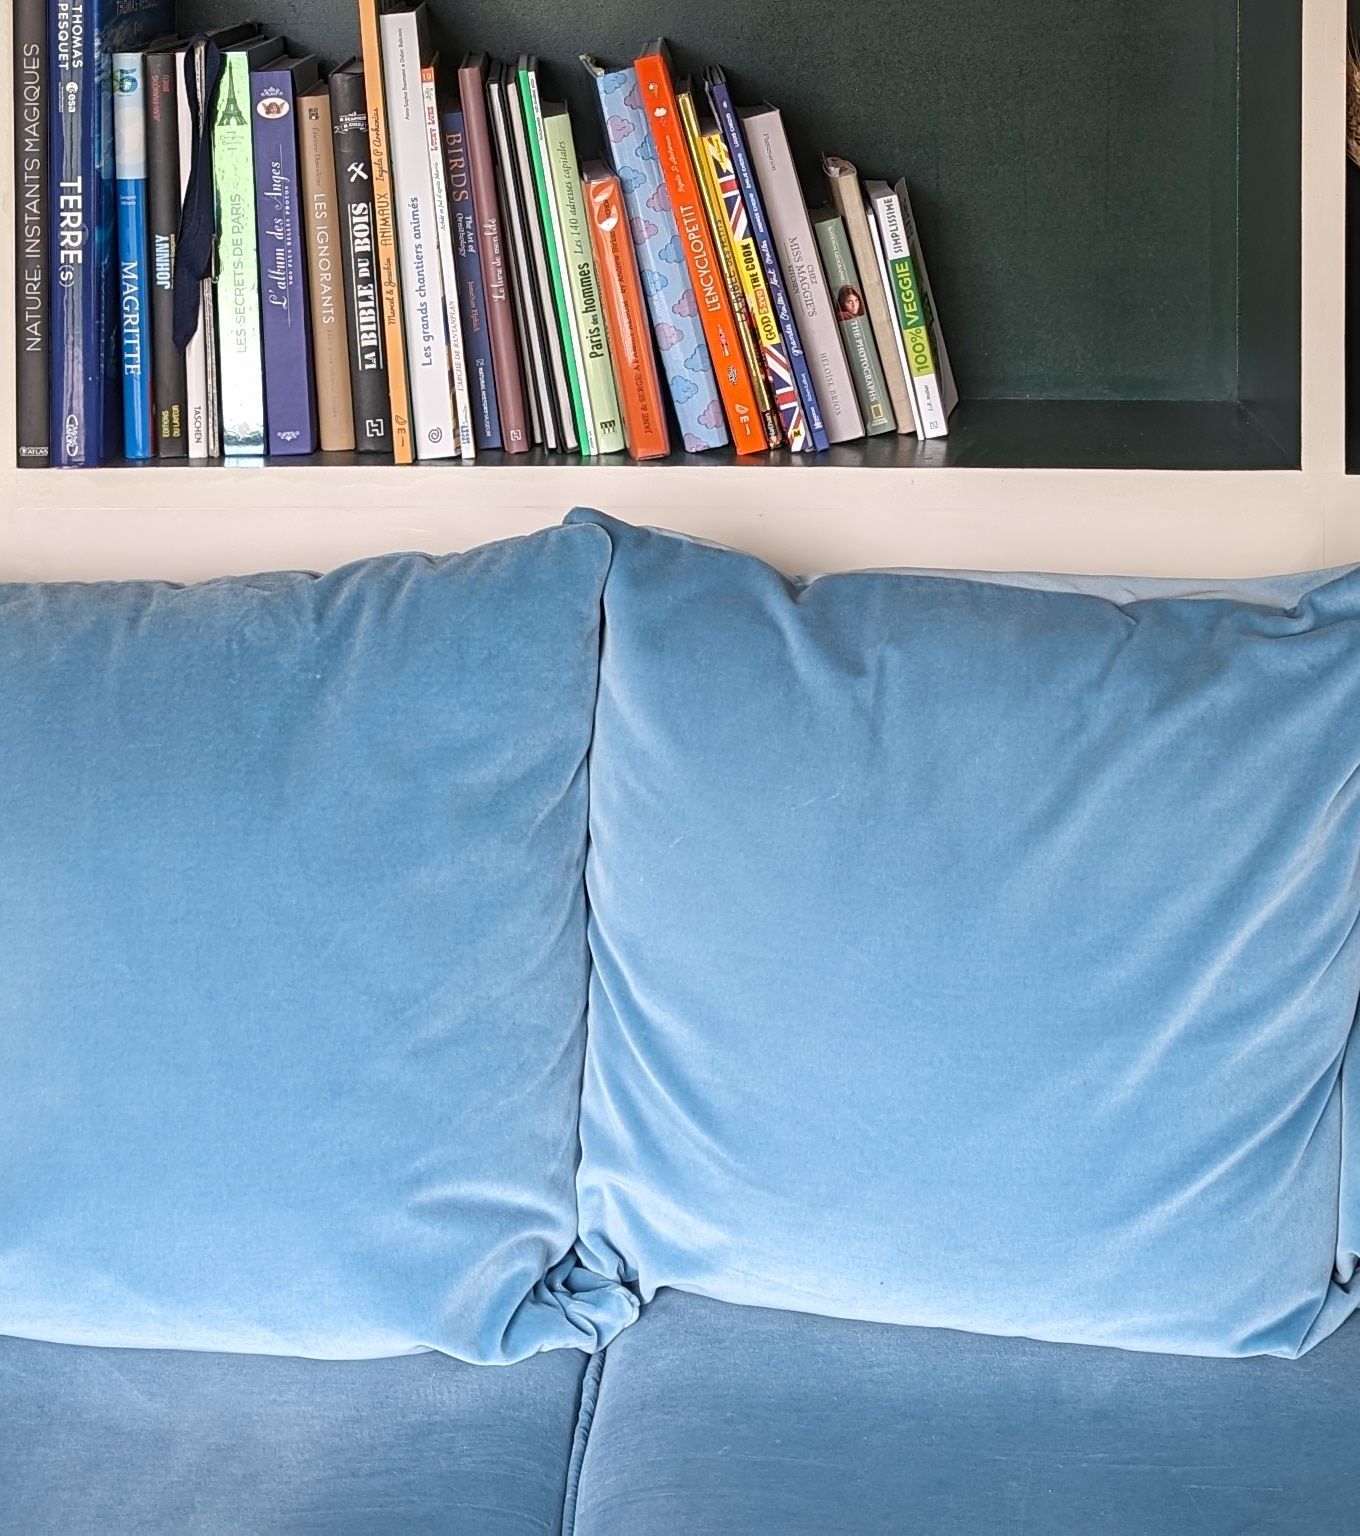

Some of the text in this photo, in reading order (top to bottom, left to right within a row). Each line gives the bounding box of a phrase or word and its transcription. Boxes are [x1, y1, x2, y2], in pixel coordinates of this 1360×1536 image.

[58, 3, 70, 70] PESQUET
[72, 4, 84, 69] THOMAS
[22, 44, 41, 152] MAGIQUES
[446, 132, 469, 202] BIRDS
[24, 157, 41, 258] INSTANTS
[59, 175, 83, 287] TERRE(s)
[263, 161, 289, 311] L'album des Anges
[313, 193, 328, 219] LES
[376, 193, 392, 247] ANIMAUX
[455, 212, 468, 258] Ornithology
[465, 214, 477, 254] The Art of
[154, 234, 171, 290] JOHNNY
[230, 193, 247, 354] LES SECRETS DE PARIS
[315, 225, 335, 324] IGNORANTS
[409, 196, 434, 367] Les grands chantiers animés
[557, 141, 604, 359] Paris des hommes Les 140 adresses capitales
[680, 204, 721, 313] L'ENCYCLOPETIT
[786, 264, 801, 295] KITCHEN
[788, 236, 817, 318] MISS MAGGIE'S
[806, 264, 818, 285] CHEZ
[882, 197, 929, 373] 100% VEGGIE SIMPLISSIME
[120, 260, 142, 376] MAGRITTE
[351, 202, 378, 370] LA BIBLE DU BOIS
[385, 295, 396, 325] Marcel
[740, 242, 777, 342] GOD THE COOK
[850, 320, 878, 402] THE PHOTOGRAPHS
[27, 448, 50, 456] ATLAS
[161, 410, 170, 438] EDITIONS
[170, 404, 180, 438] DU LAYEUR
[193, 406, 202, 444] TASCHEN
[764, 411, 778, 439] Nathan
